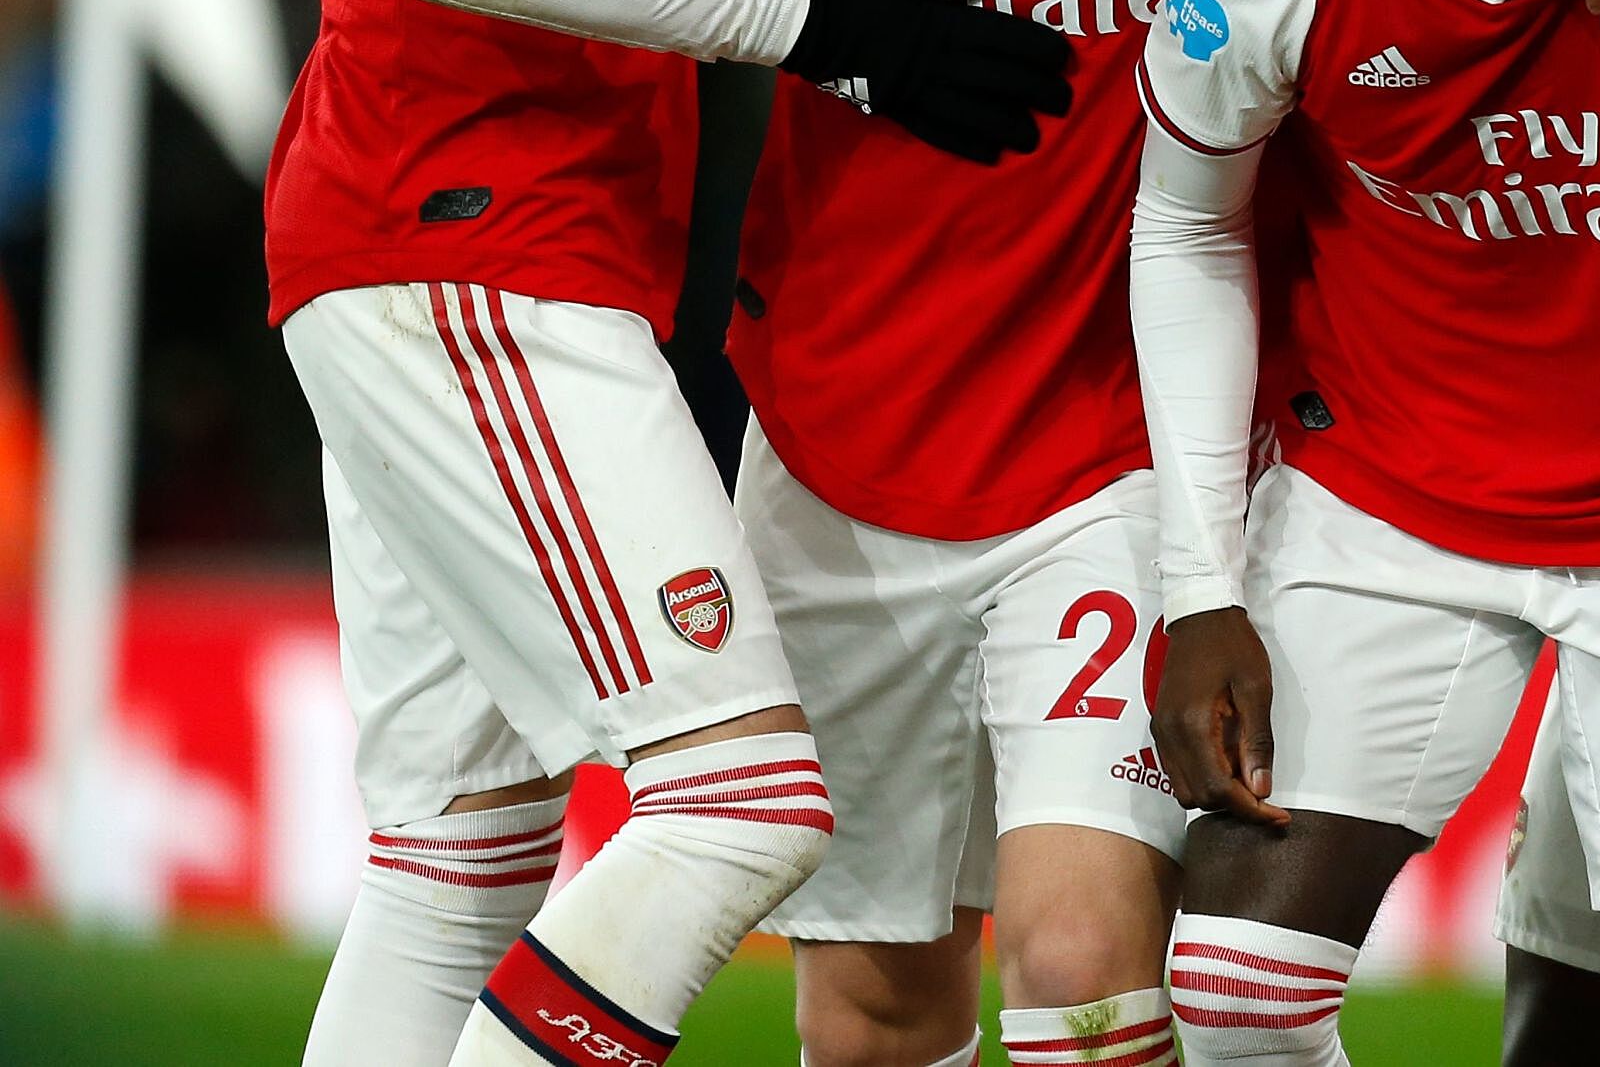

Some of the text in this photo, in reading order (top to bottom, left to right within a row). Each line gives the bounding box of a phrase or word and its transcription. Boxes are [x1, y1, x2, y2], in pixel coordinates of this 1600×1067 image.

[1181, 9, 1197, 32] Up
[1348, 71, 1432, 88] adidas
[1469, 109, 1600, 167] Fly
[668, 577, 719, 607] Arsenal
[1043, 590, 1171, 722] 2
[1110, 763, 1177, 800] adida
